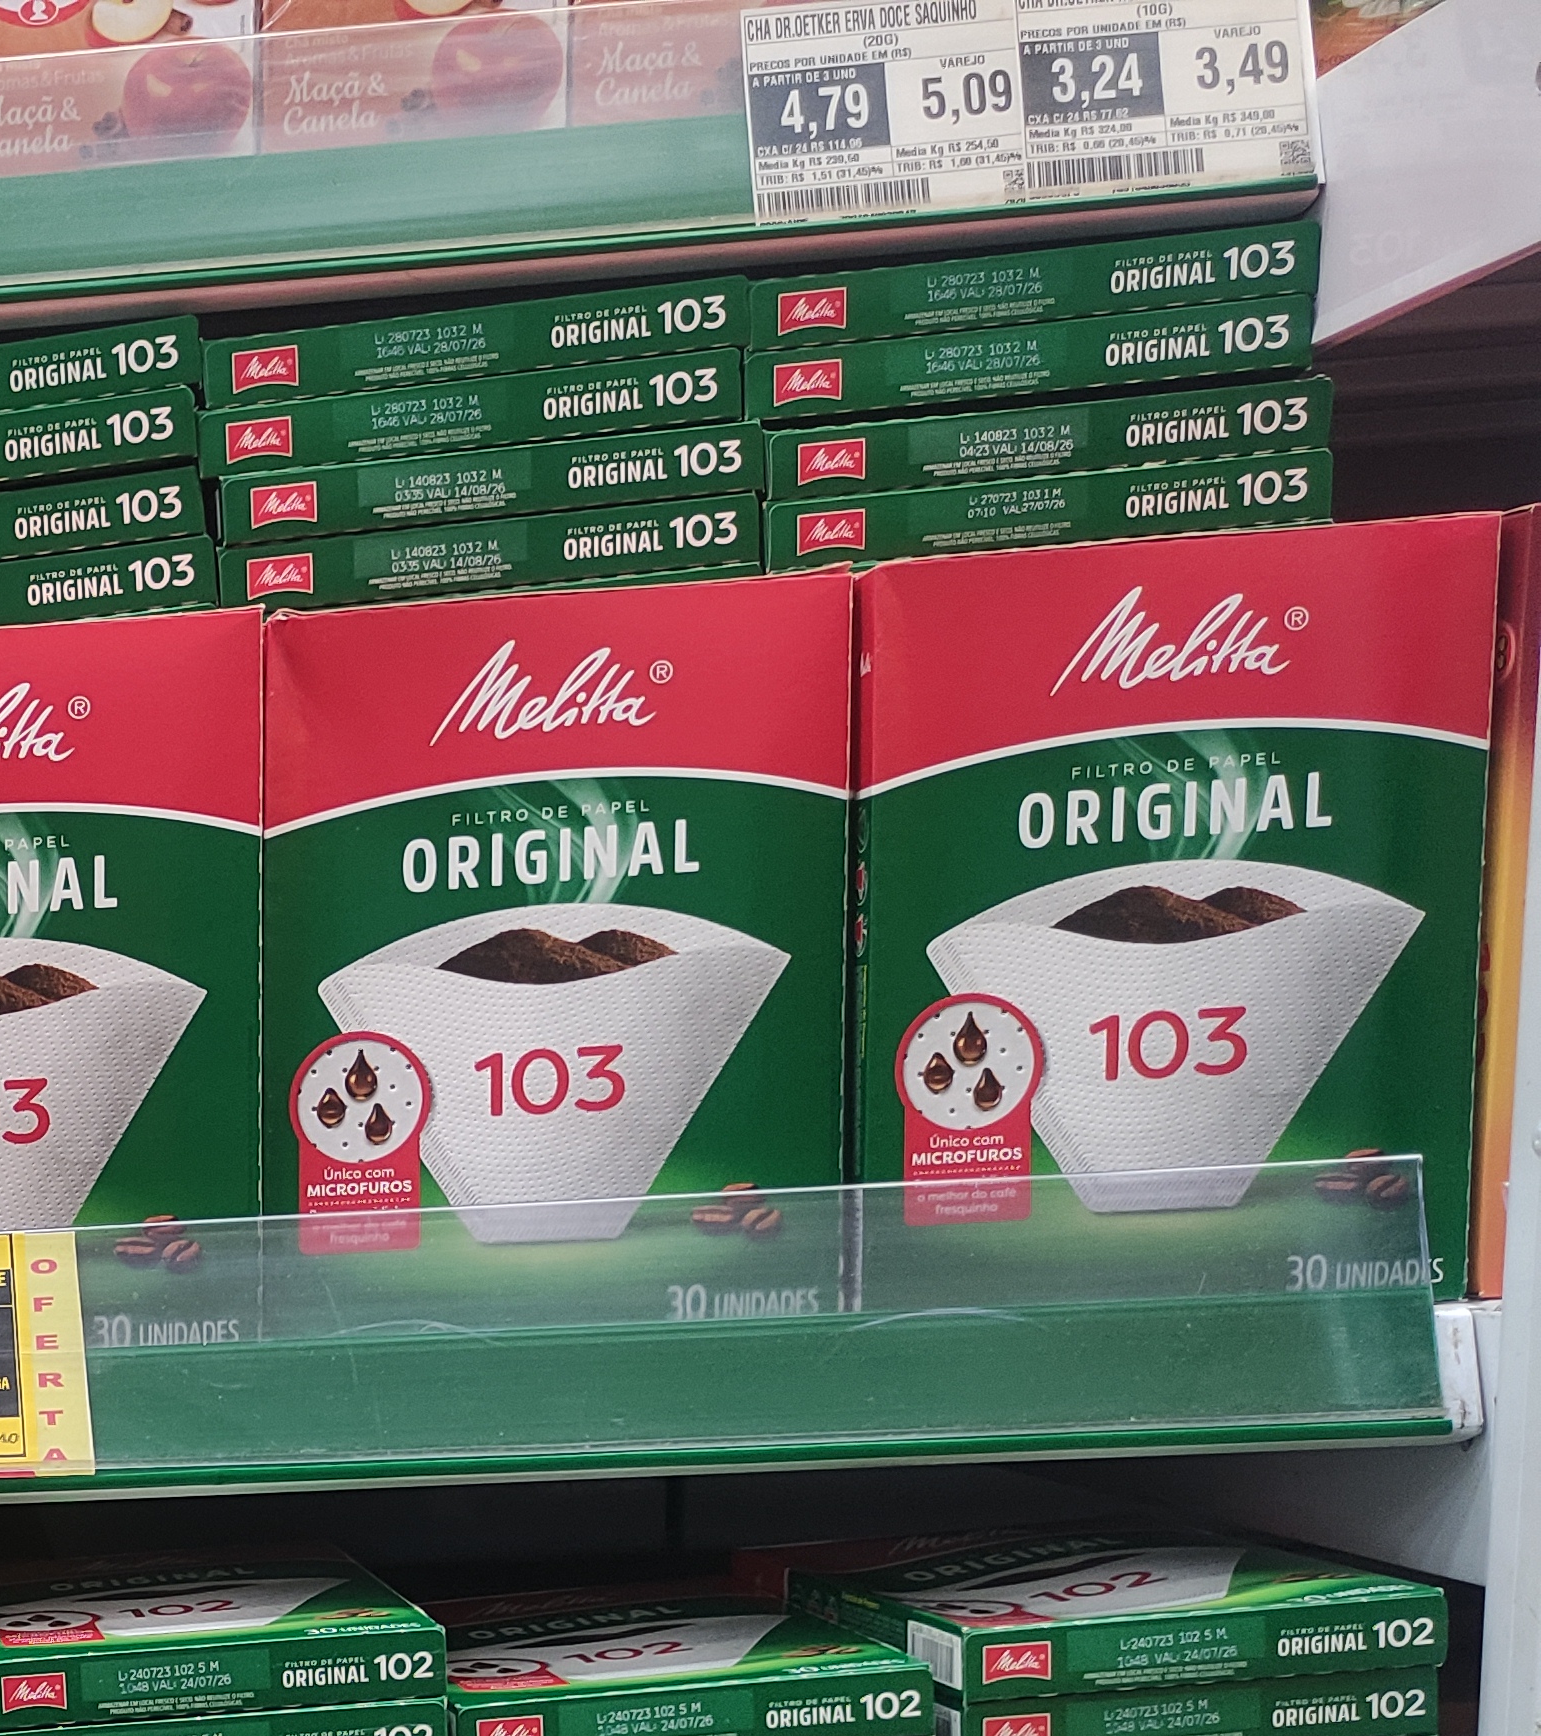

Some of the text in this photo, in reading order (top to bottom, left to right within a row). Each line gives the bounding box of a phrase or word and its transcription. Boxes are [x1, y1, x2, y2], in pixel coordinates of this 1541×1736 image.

[747, 0, 976, 42] CHA DR.OETKER ERVA DOCE SAQUINHO
[863, 34, 899, 48] (20G)
[1051, 52, 1143, 108] 3,24
[1195, 40, 1289, 95] 3,49
[780, 83, 869, 139] 4,79
[922, 69, 1012, 124] 5,09
[1109, 241, 1296, 295] ORIGINAL 103
[1051, 586, 1291, 697] Melitta
[429, 639, 657, 747] Melitta
[1017, 770, 1334, 850] ORIGINAL
[401, 818, 700, 894] ORIGINAL
[1089, 1004, 1249, 1082] 103
[473, 1044, 627, 1118] 103
[1277, 1617, 1435, 1656] ORIGINAL 102
